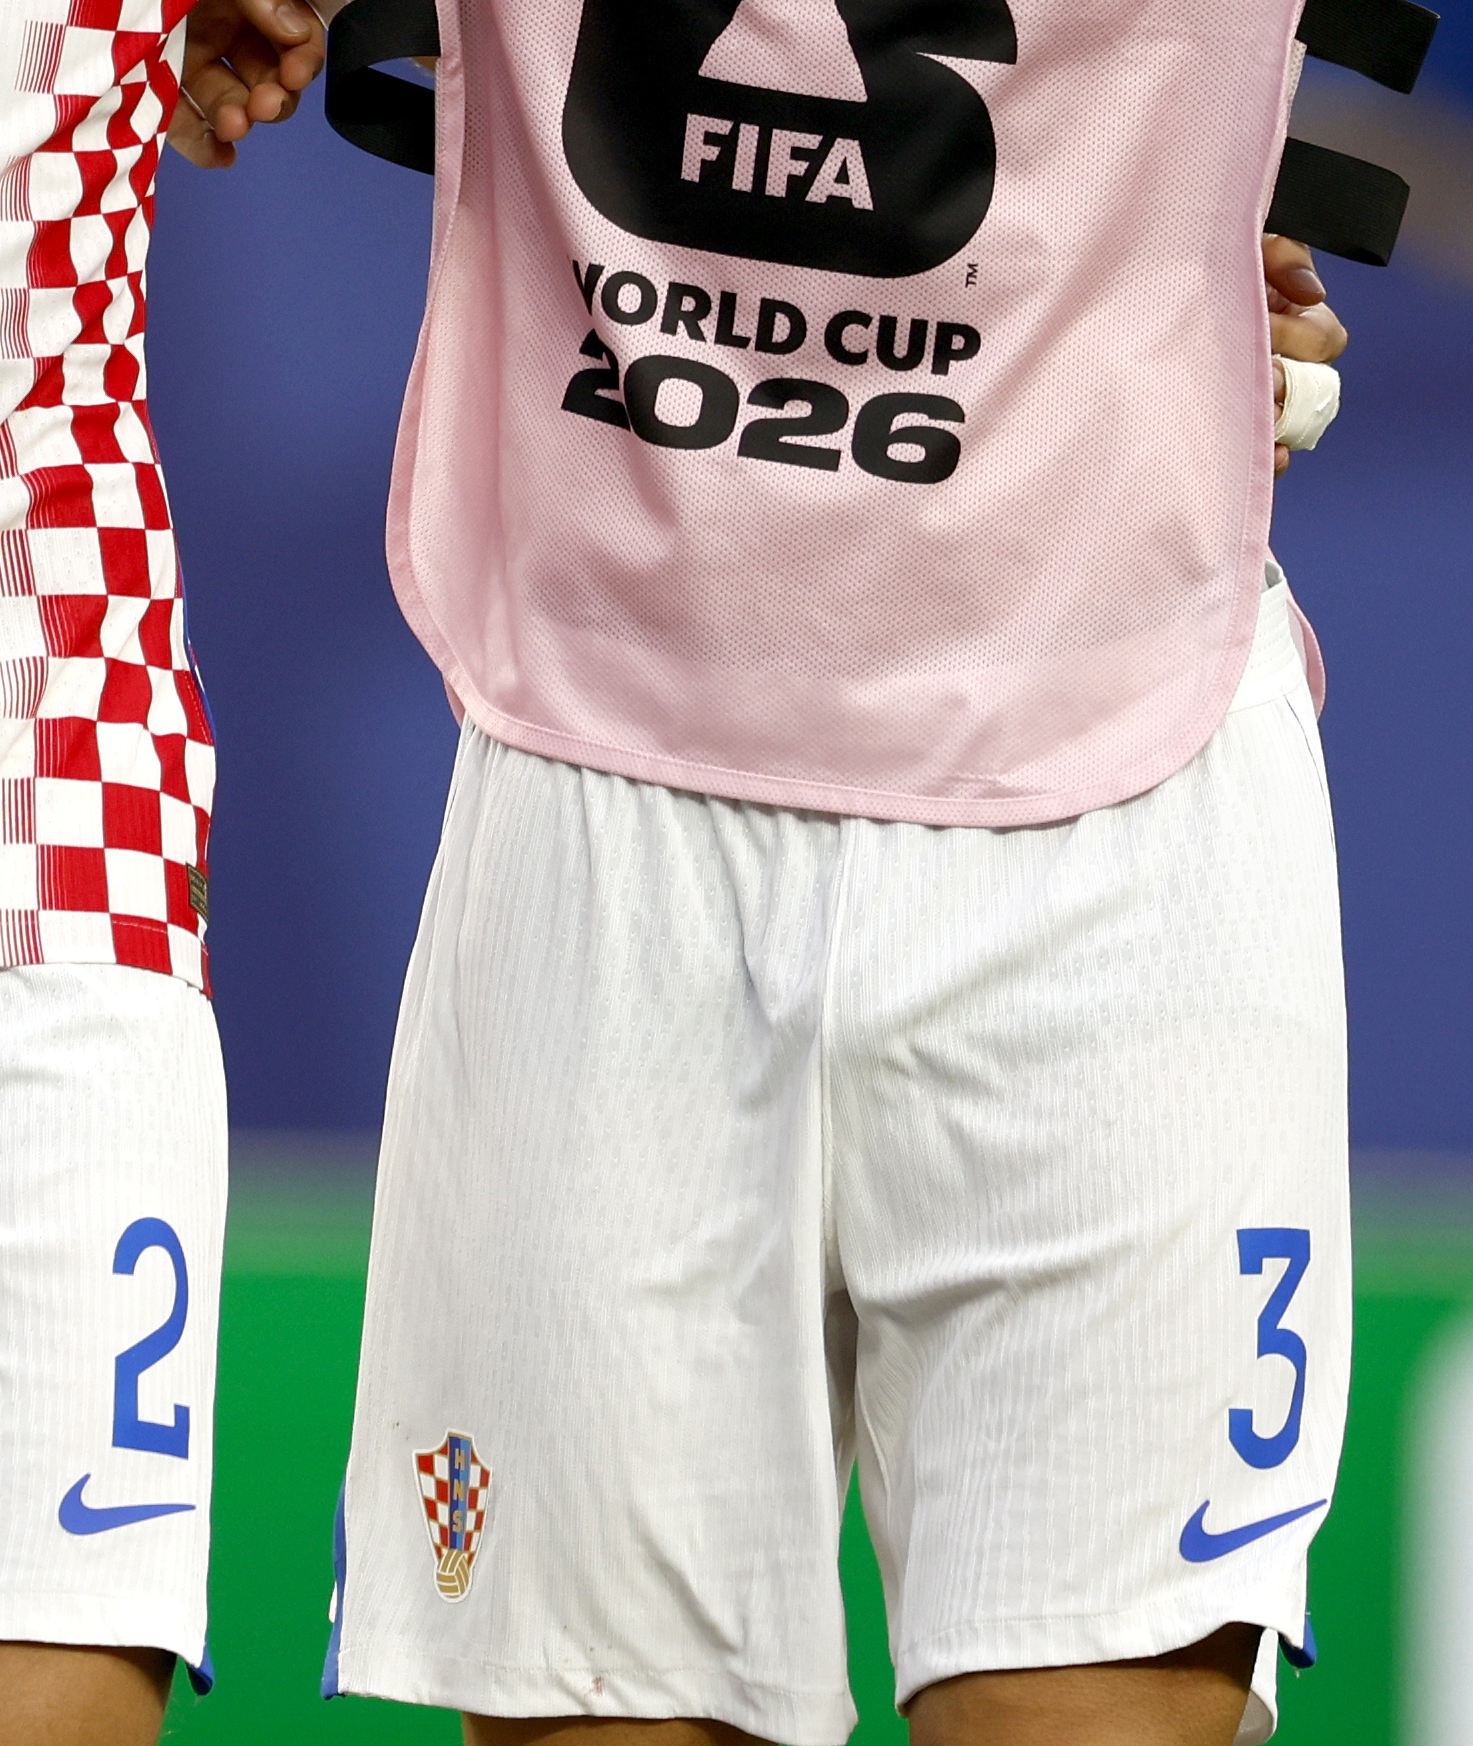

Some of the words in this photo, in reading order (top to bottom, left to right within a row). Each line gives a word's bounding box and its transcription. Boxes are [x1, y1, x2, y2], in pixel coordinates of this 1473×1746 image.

[680, 112, 874, 212] FIFA
[560, 328, 966, 485] 2026
[823, 309, 982, 376] CUP
[111, 1216, 190, 1460] 2
[1228, 1227, 1311, 1470] 3
[452, 1448, 465, 1533] HNS
